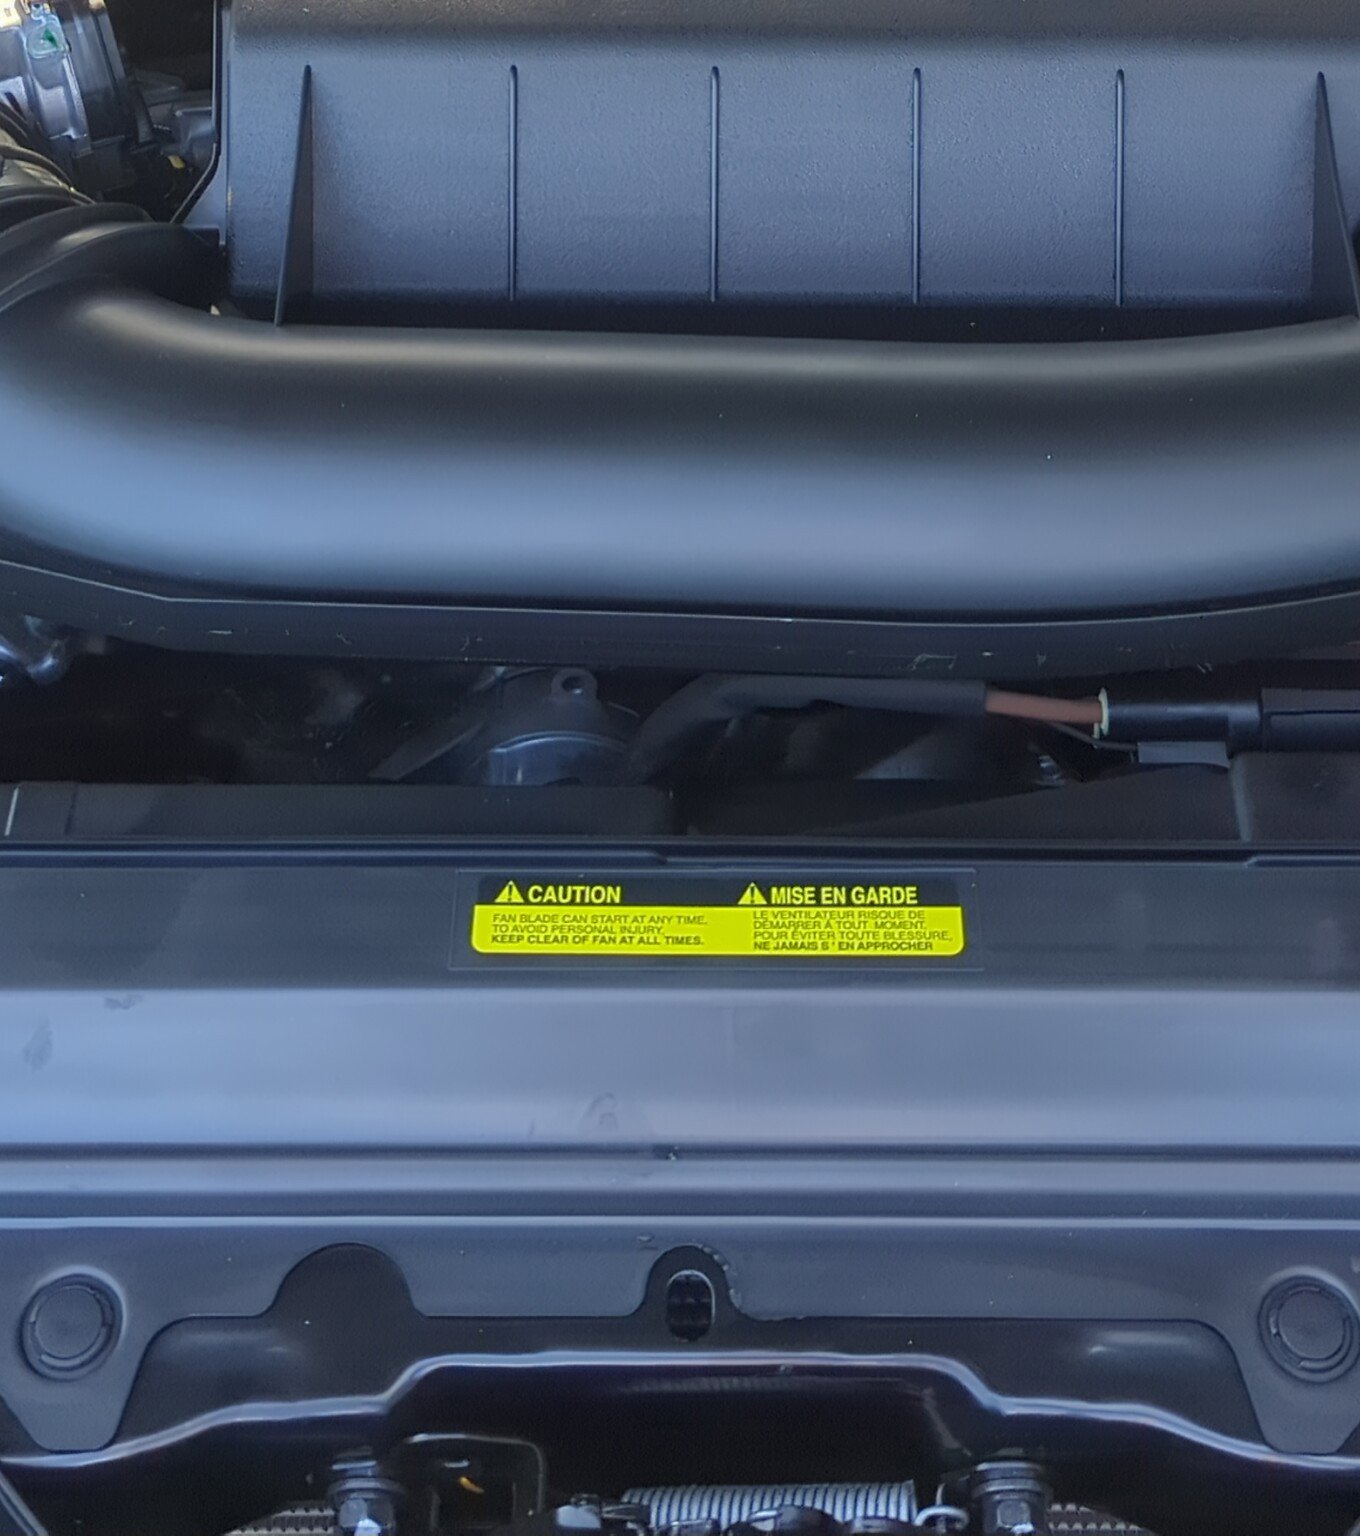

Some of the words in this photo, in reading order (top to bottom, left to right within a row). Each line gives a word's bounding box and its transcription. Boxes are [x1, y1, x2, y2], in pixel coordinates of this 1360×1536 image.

[527, 884, 622, 904] CAUTION
[770, 886, 817, 905] MISE
[820, 886, 847, 905] EN
[850, 886, 919, 905] GARDE
[492, 912, 517, 923] FAN
[519, 913, 559, 924] BLADE
[561, 913, 588, 924] CAN
[590, 914, 629, 925] START
[630, 914, 647, 925] AT
[648, 915, 674, 925] ANY
[752, 909, 769, 919] LE
[771, 909, 855, 920] VENTILATEUR
[857, 910, 905, 920] RISQUE
[908, 910, 925, 920] DE
[492, 923, 510, 934] TO
[510, 923, 549, 934] AVOID
[550, 924, 617, 935] PERSONAL
[836, 920, 869, 930] TOUT
[491, 934, 525, 944] KEEP
[526, 934, 570, 945] CLEAR
[571, 934, 590, 945] OF
[591, 935, 617, 945] FAN
[618, 935, 635, 945] AT
[636, 935, 662, 946] ALL
[753, 930, 789, 941] POUR
[839, 930, 881, 941] TOUTE
[753, 941, 771, 951] NE
[772, 941, 819, 952] JAMAIS
[856, 942, 934, 952] APPROCHER
